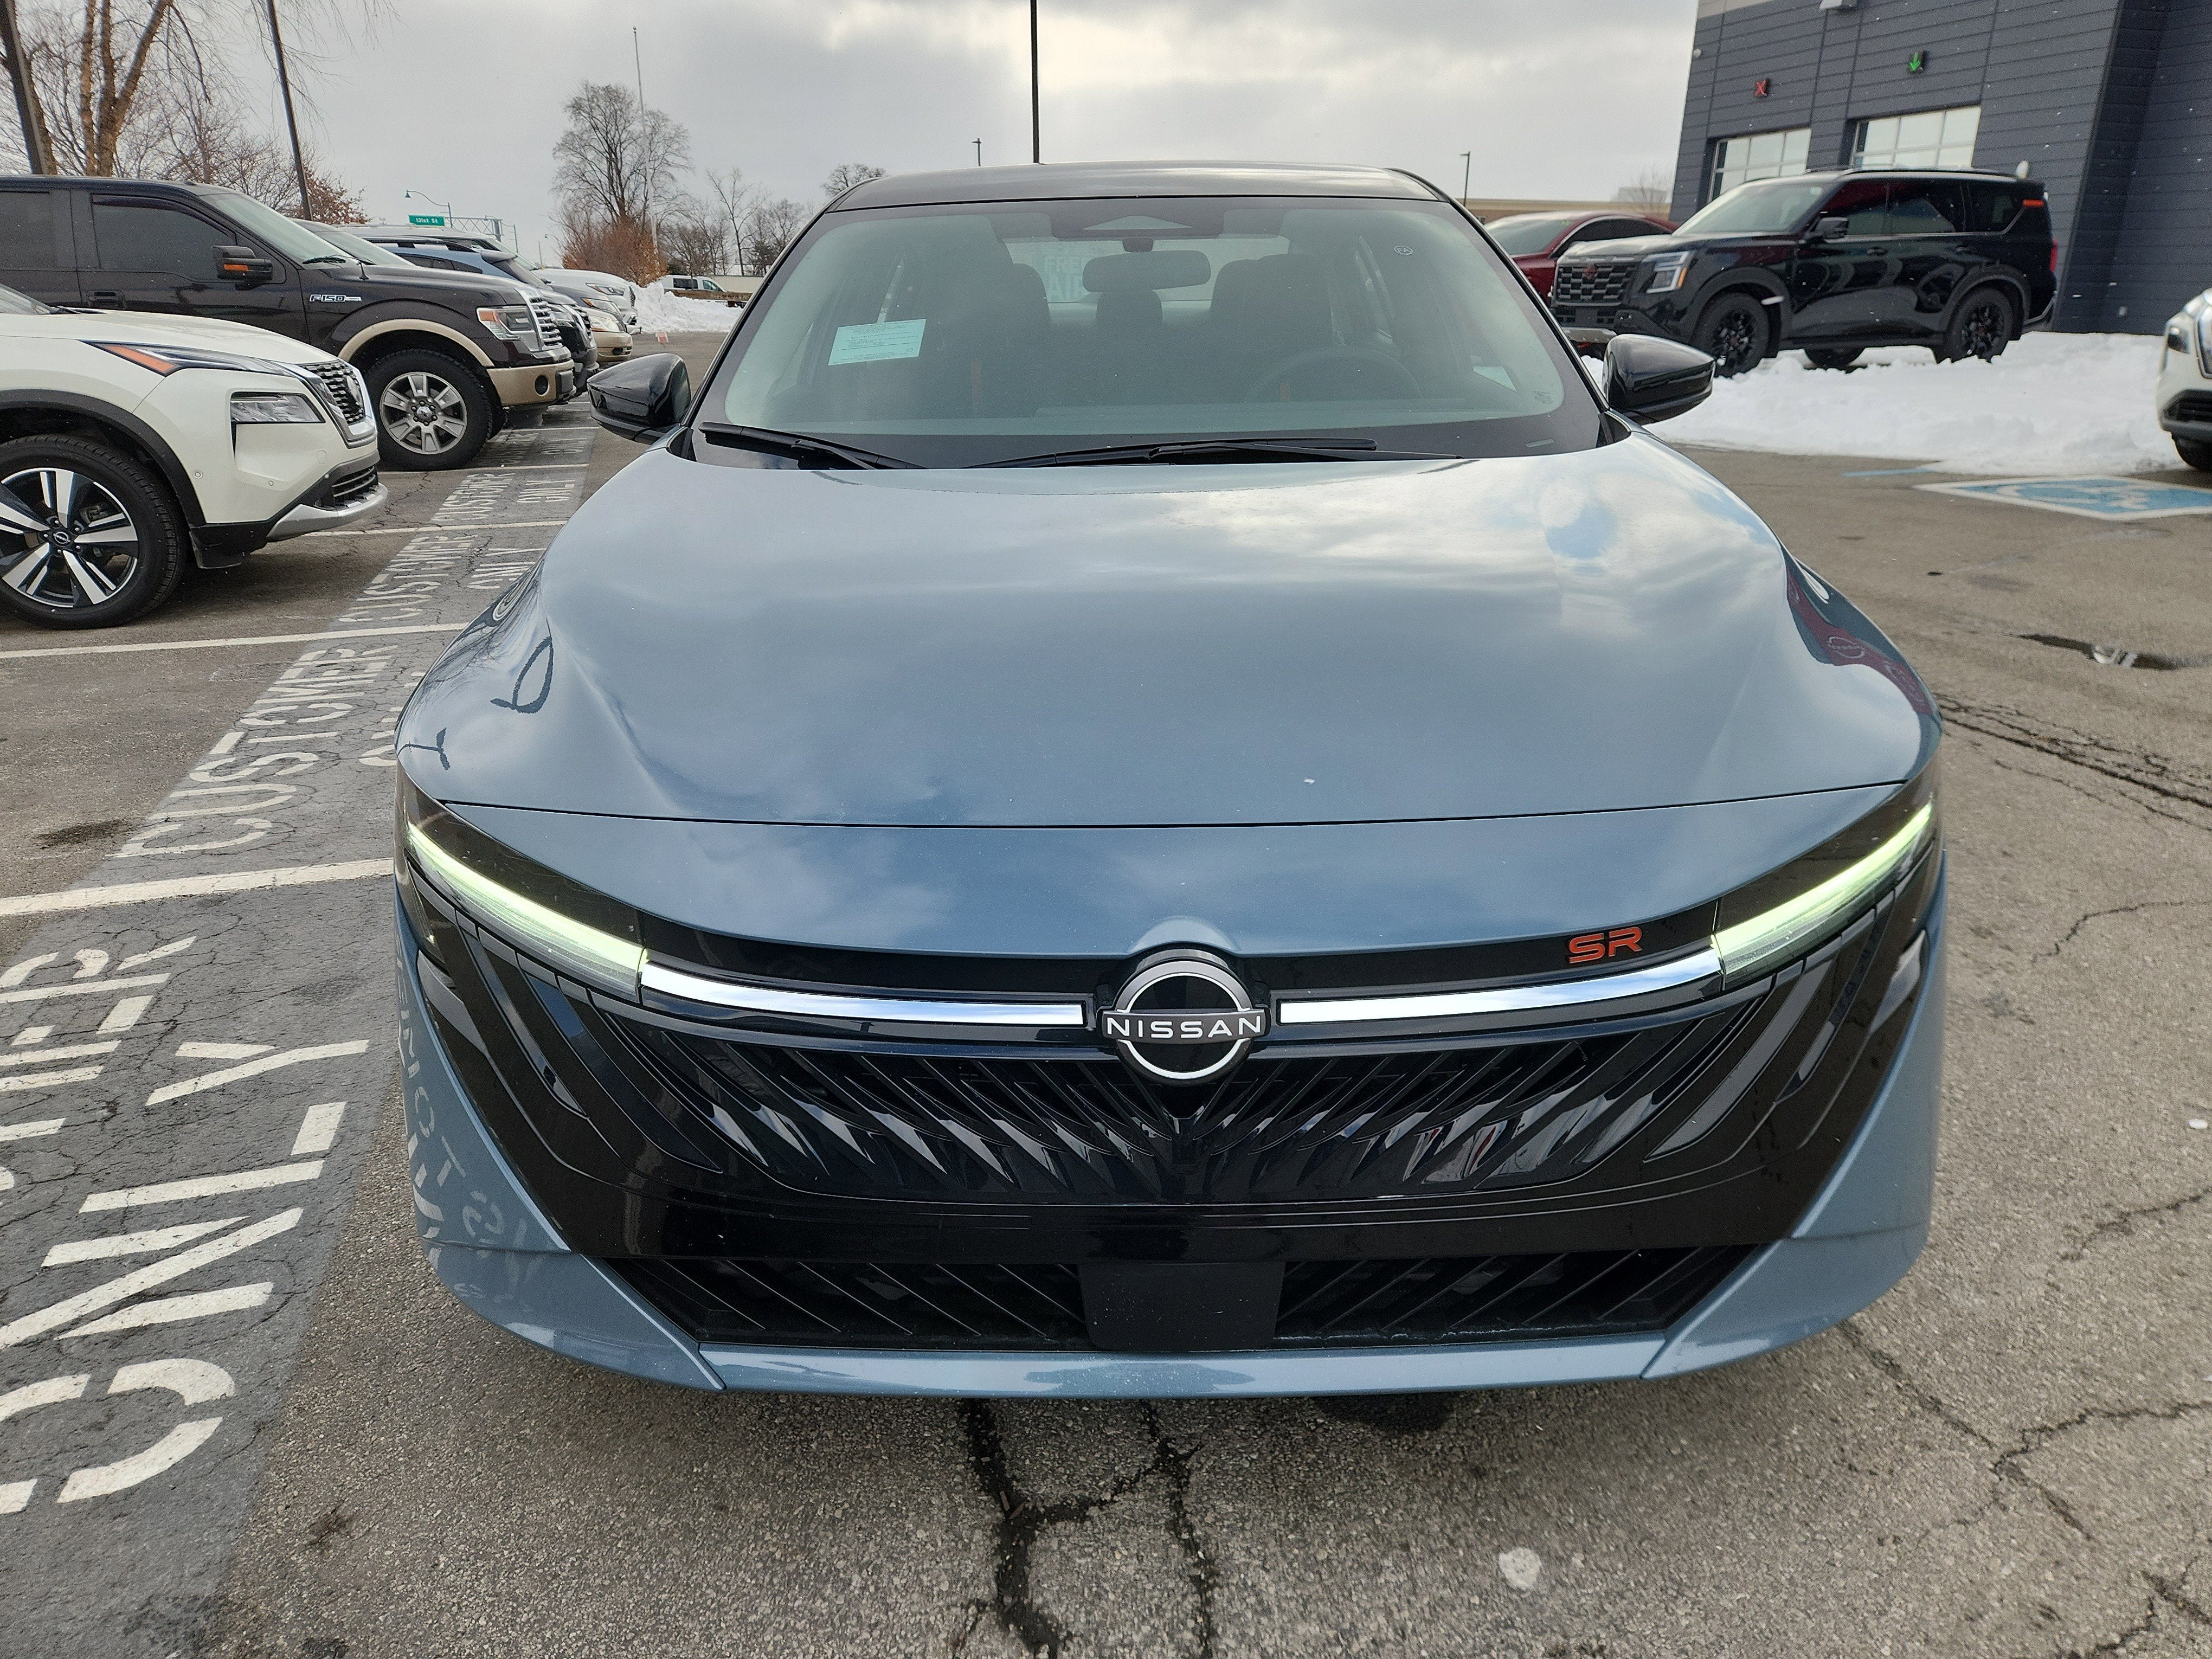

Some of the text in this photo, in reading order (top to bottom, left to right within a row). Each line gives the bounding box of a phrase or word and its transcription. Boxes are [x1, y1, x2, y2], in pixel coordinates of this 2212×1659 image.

[430, 473, 516, 521] CUSTOMER
[516, 479, 576, 503] ONLY
[338, 535, 478, 622] CUSTOMER
[105, 645, 398, 858] CUSTOMER
[1568, 926, 1643, 964] SR
[1107, 1015, 1261, 1039] NISSAN
